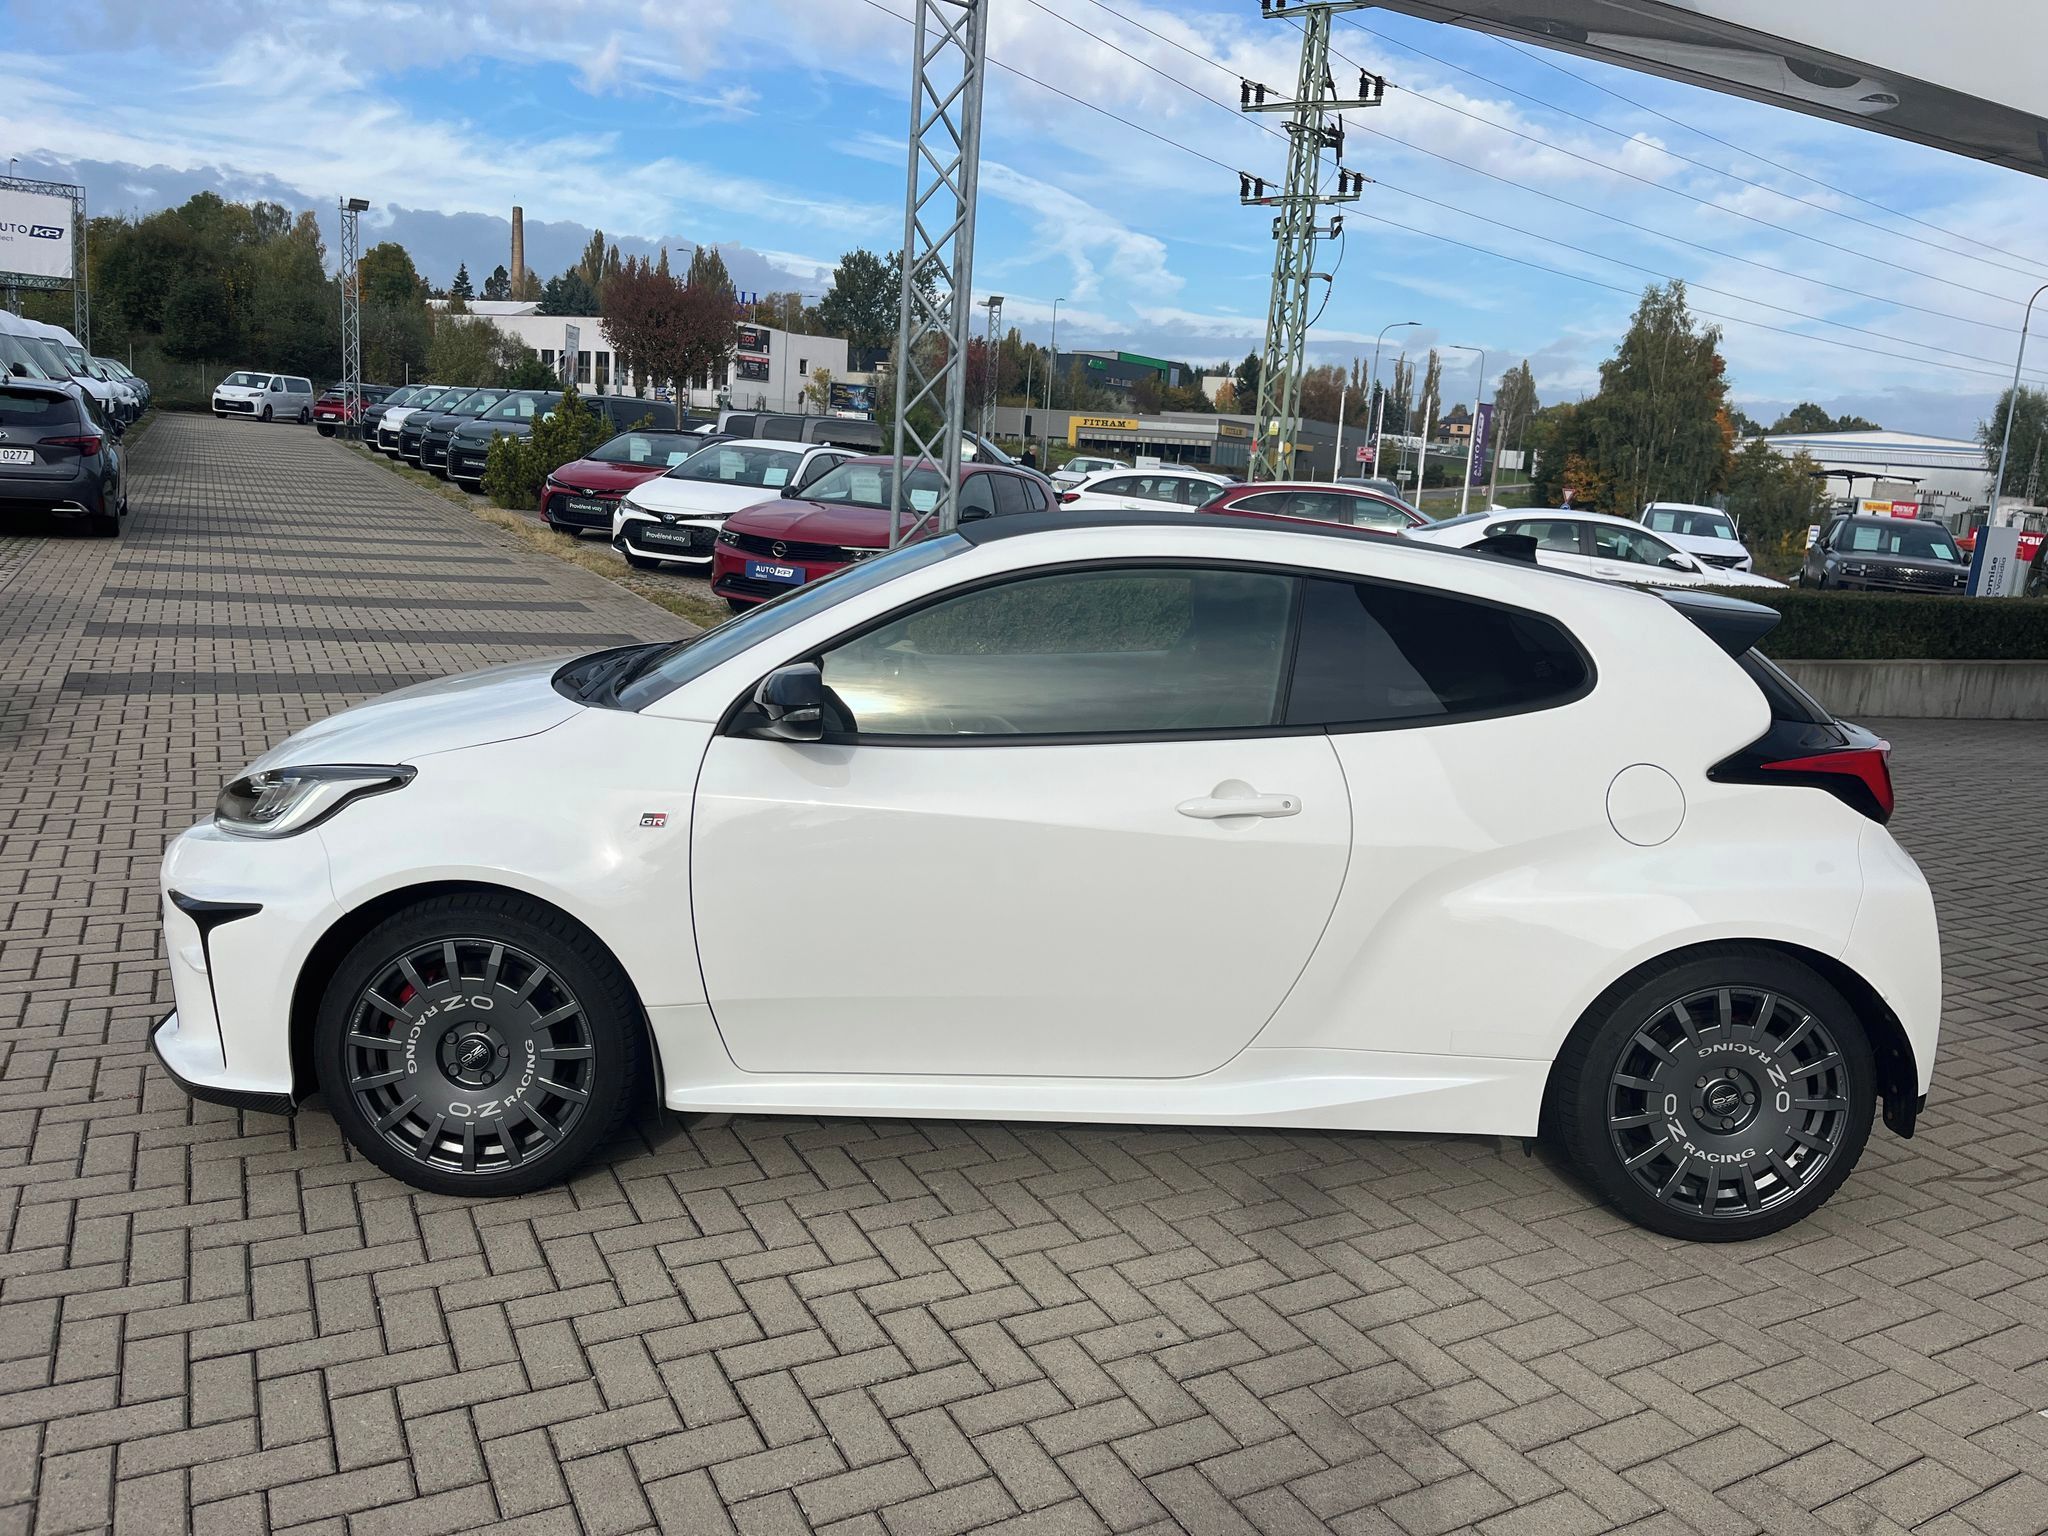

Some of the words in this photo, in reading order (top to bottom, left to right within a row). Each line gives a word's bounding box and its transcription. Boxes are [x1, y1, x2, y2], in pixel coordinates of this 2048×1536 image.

[0, 222, 27, 234] UTO
[1083, 418, 1126, 428] FITHAM
[3, 450, 28, 460] 0277
[755, 565, 775, 574] AUTO
[1986, 557, 1999, 595] omise
[406, 1005, 438, 1075] RACING
[1698, 1042, 1771, 1065] RACING
[504, 1039, 536, 1108] RACING
[1683, 1141, 1756, 1163] RACING
